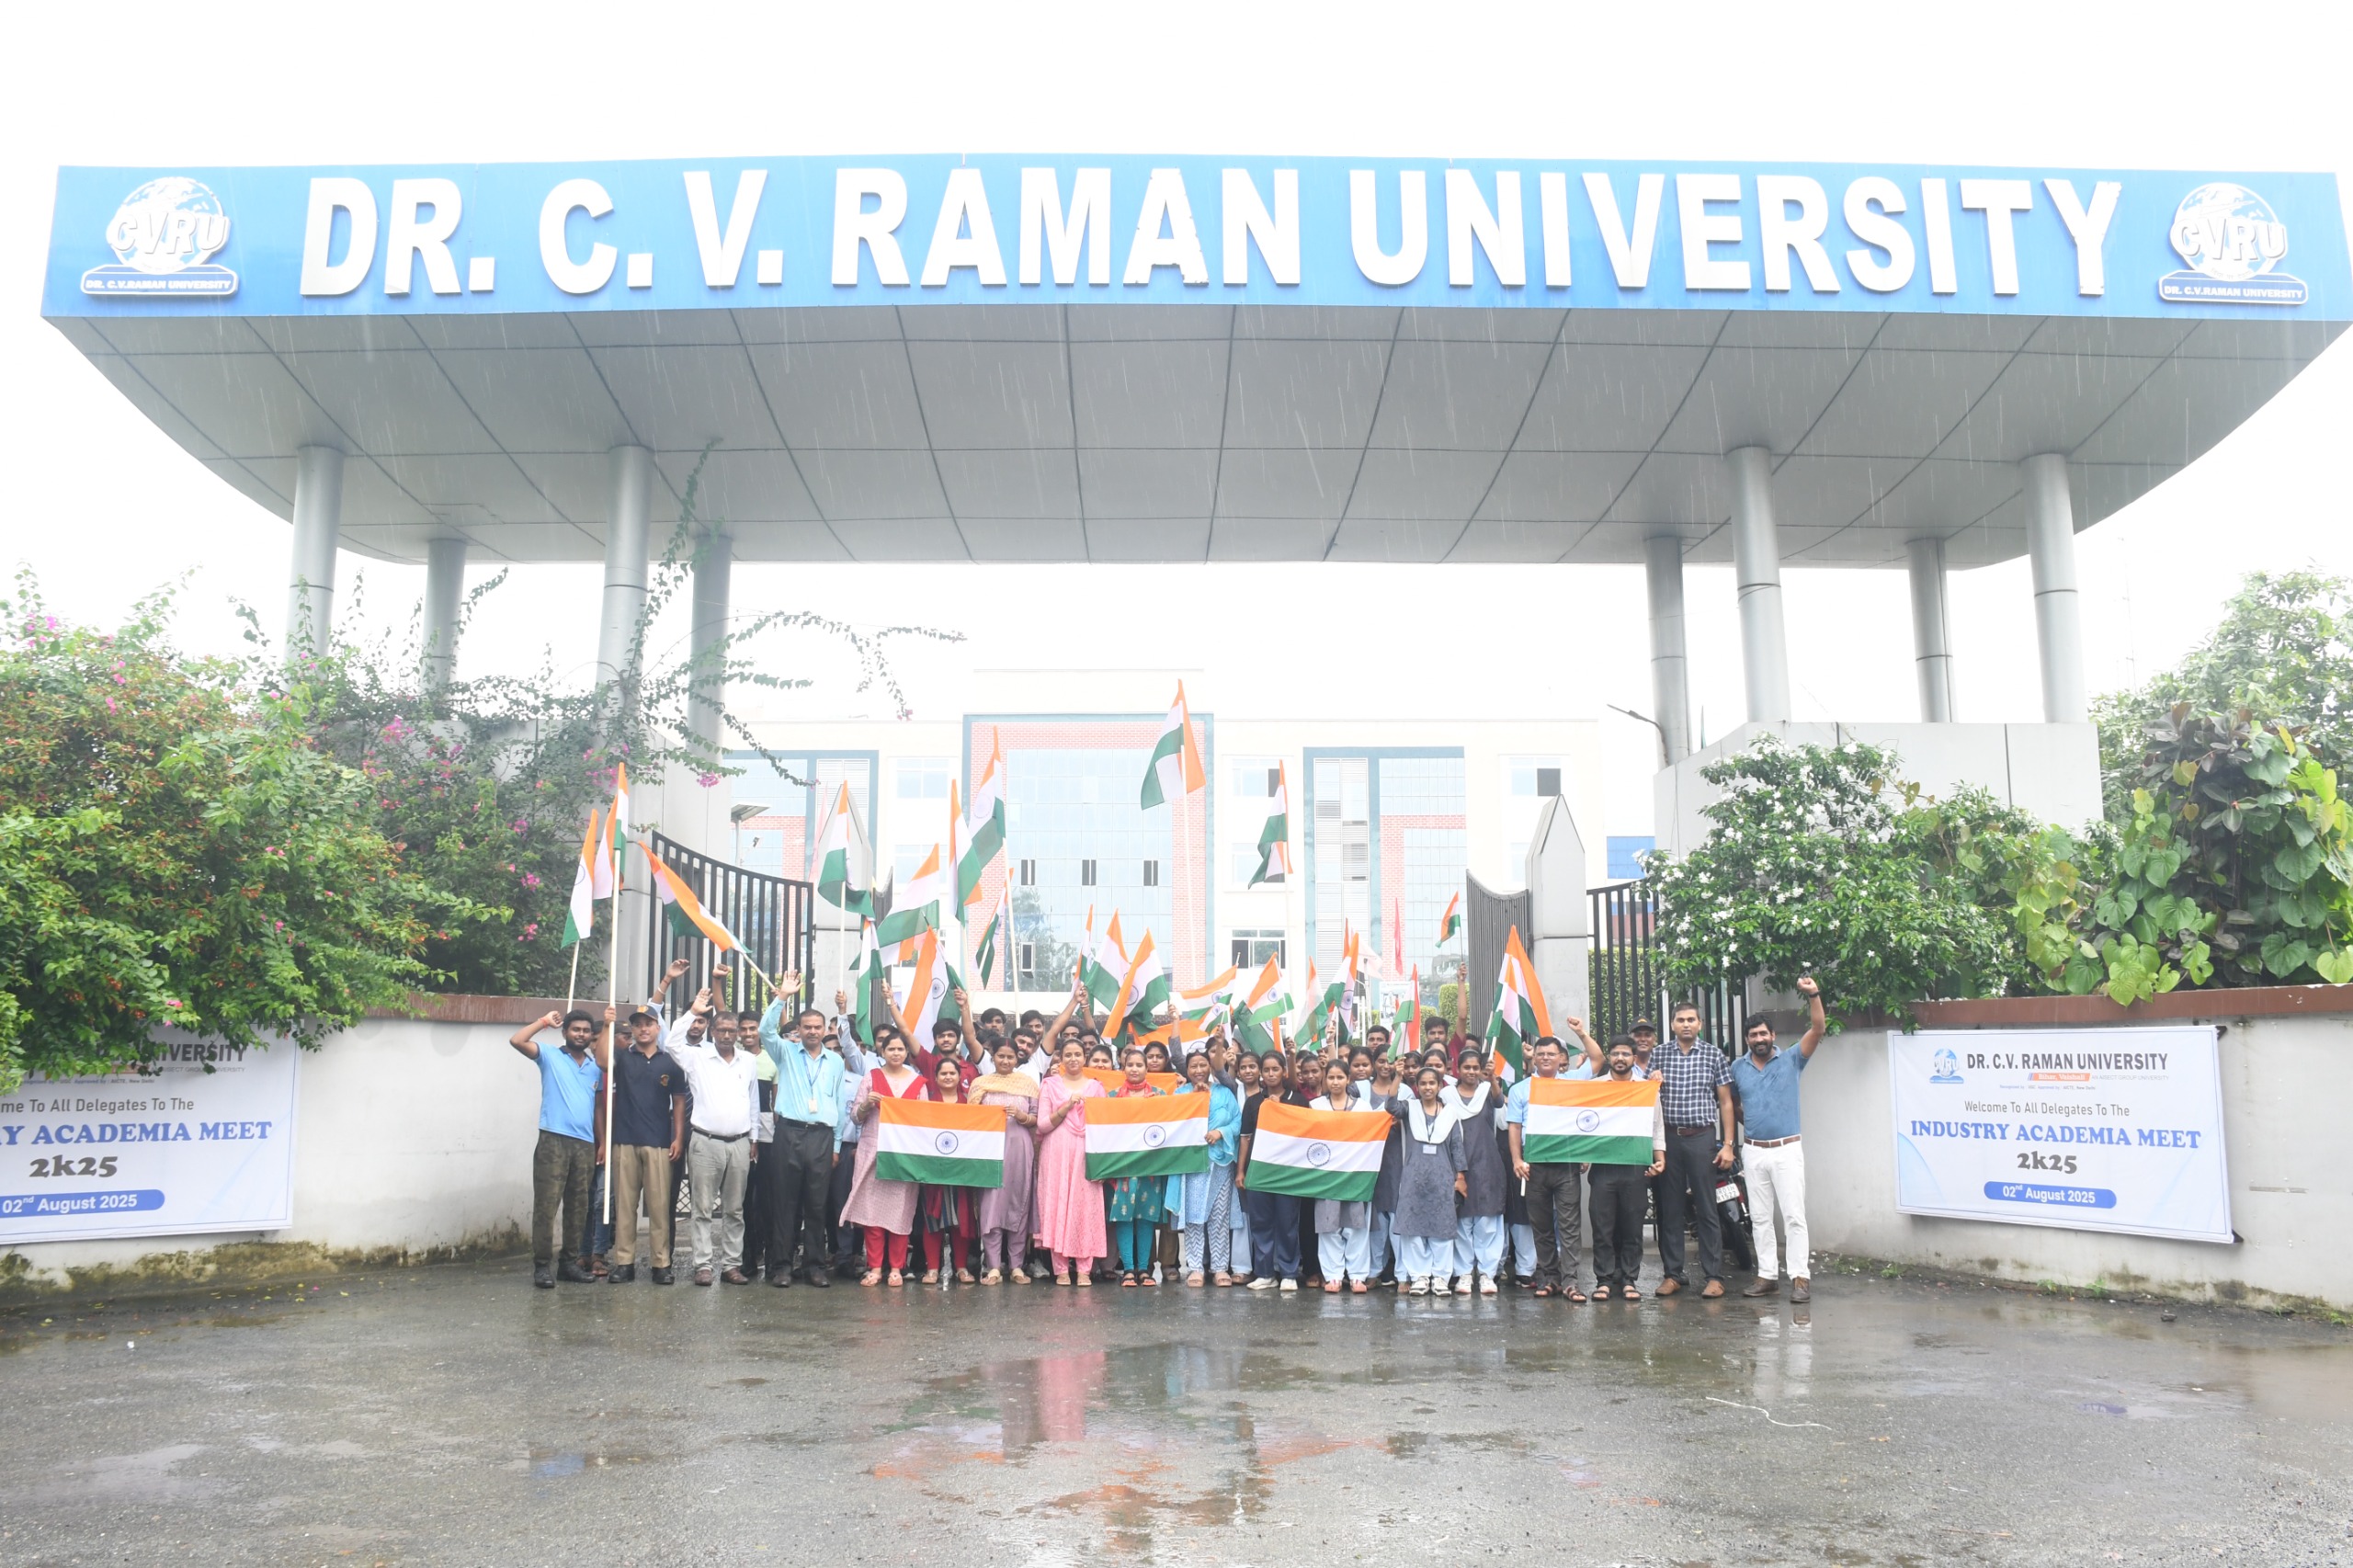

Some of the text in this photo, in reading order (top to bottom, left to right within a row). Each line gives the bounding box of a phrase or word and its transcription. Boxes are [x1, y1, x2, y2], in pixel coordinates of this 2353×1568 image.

[112, 210, 227, 255] CVRU
[301, 167, 2121, 296] DR. C. V. RAMAN UNIVERSITY
[2178, 218, 2287, 261] CVRU
[85, 279, 105, 289] DR.
[167, 280, 231, 290] UNIVERSITY
[2164, 285, 2183, 295] DR.
[2243, 288, 2303, 299] UNIVERSITY
[153, 1043, 246, 1062] IVERSITY
[1967, 1052, 2168, 1071] DR. C.V. RAMAN UNIVERSITY
[29, 1099, 45, 1113] To
[51, 1099, 71, 1113] All
[76, 1097, 147, 1115] Delegates
[152, 1097, 167, 1111] To
[171, 1096, 195, 1111] The
[1965, 1100, 2130, 1118] Welcome To All Delegates To The
[0, 1120, 273, 1146] Y ACADEMIA MEET
[1911, 1119, 2201, 1149] INDUSTRY ACADEMIA MEET
[28, 1154, 119, 1178] 2k25
[2017, 1151, 2077, 1175] 2k25
[37, 1196, 96, 1214] August
[99, 1194, 138, 1210] 2025
[2025, 1187, 2066, 1204] August
[2068, 1190, 2096, 1204] 2025
